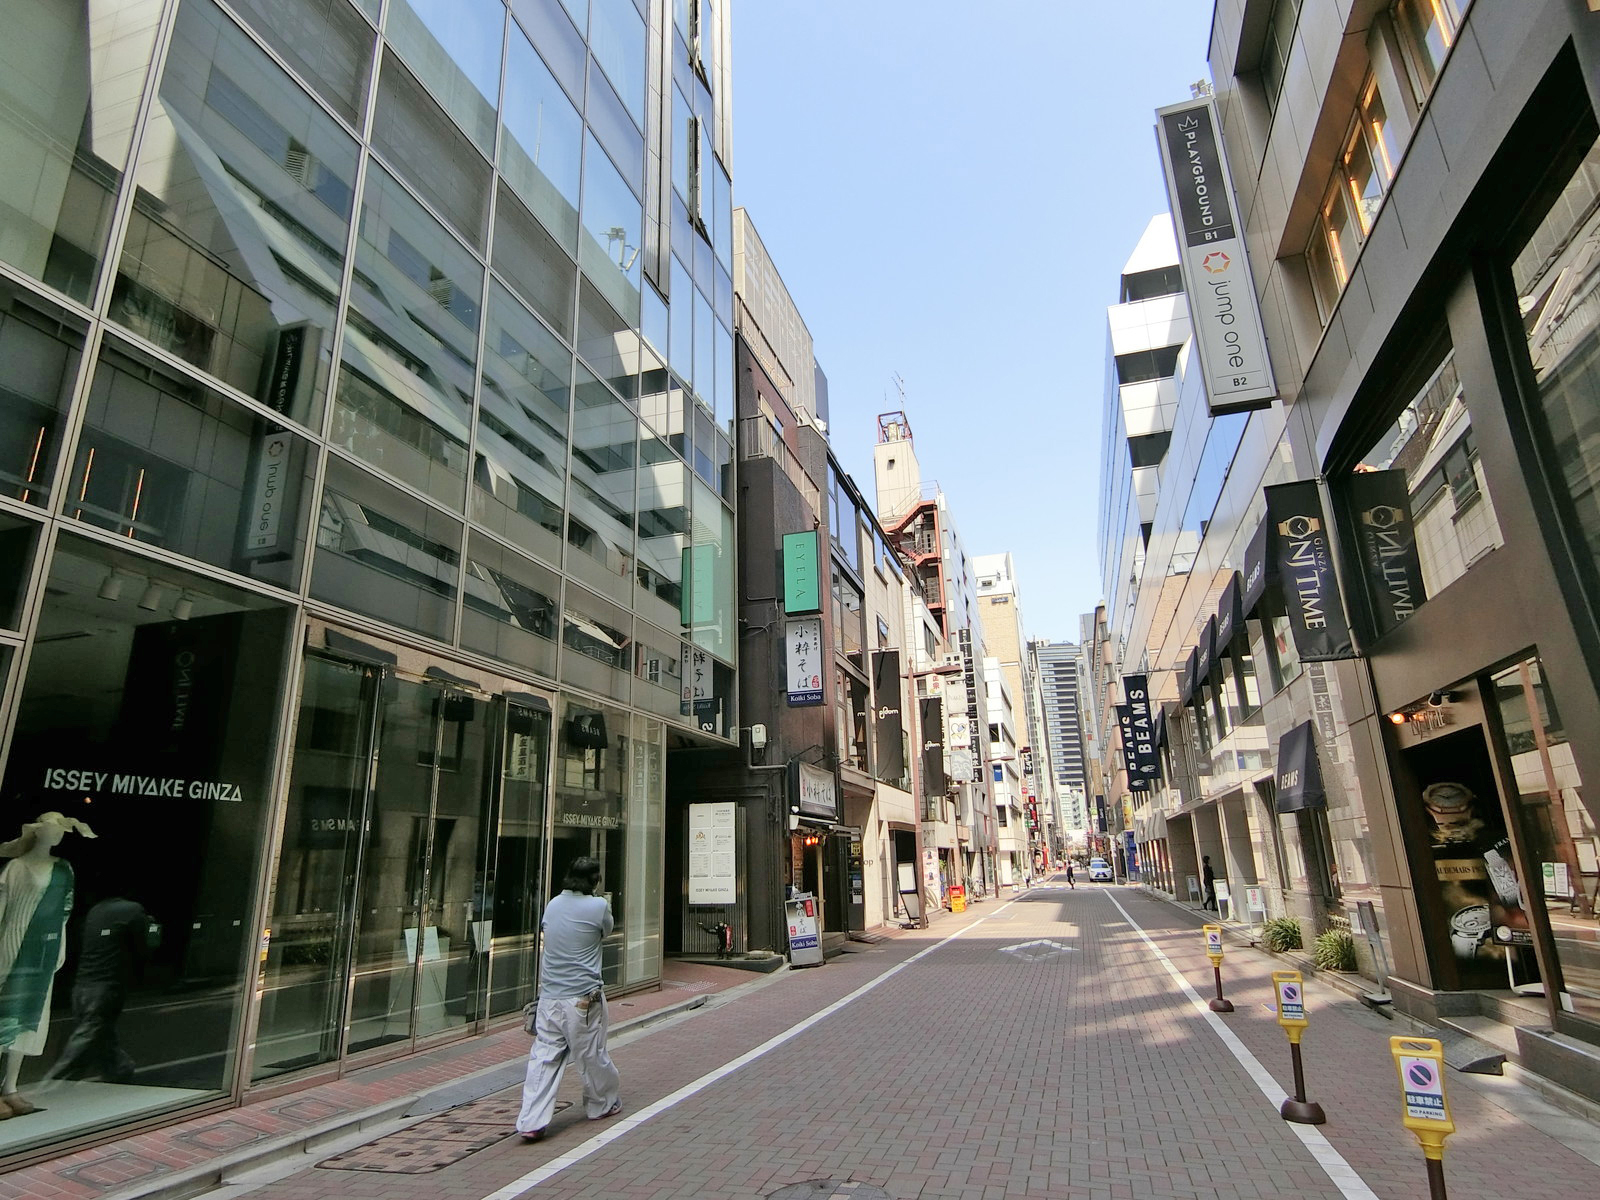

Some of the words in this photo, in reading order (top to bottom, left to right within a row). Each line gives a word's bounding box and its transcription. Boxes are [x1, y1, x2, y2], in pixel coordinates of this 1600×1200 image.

[1185, 131, 1213, 226] PLAYGROUND
[1204, 231, 1218, 240] B1
[1208, 281, 1235, 325] jump
[1224, 331, 1244, 368] one
[1233, 377, 1248, 387] B2
[1313, 537, 1328, 573] GINZA
[796, 543, 806, 600] EYELA
[1130, 689, 1153, 754] BEAMS
[44, 768, 108, 792] ISSEY
[111, 774, 185, 798] MIYAKE
[189, 781, 243, 802] GINZA
[1280, 769, 1299, 790] BEAMS
[563, 813, 580, 825] ISSEY
[1406, 1095, 1443, 1107] 駐車禁止
[1420, 1109, 1443, 1117] PARKING
